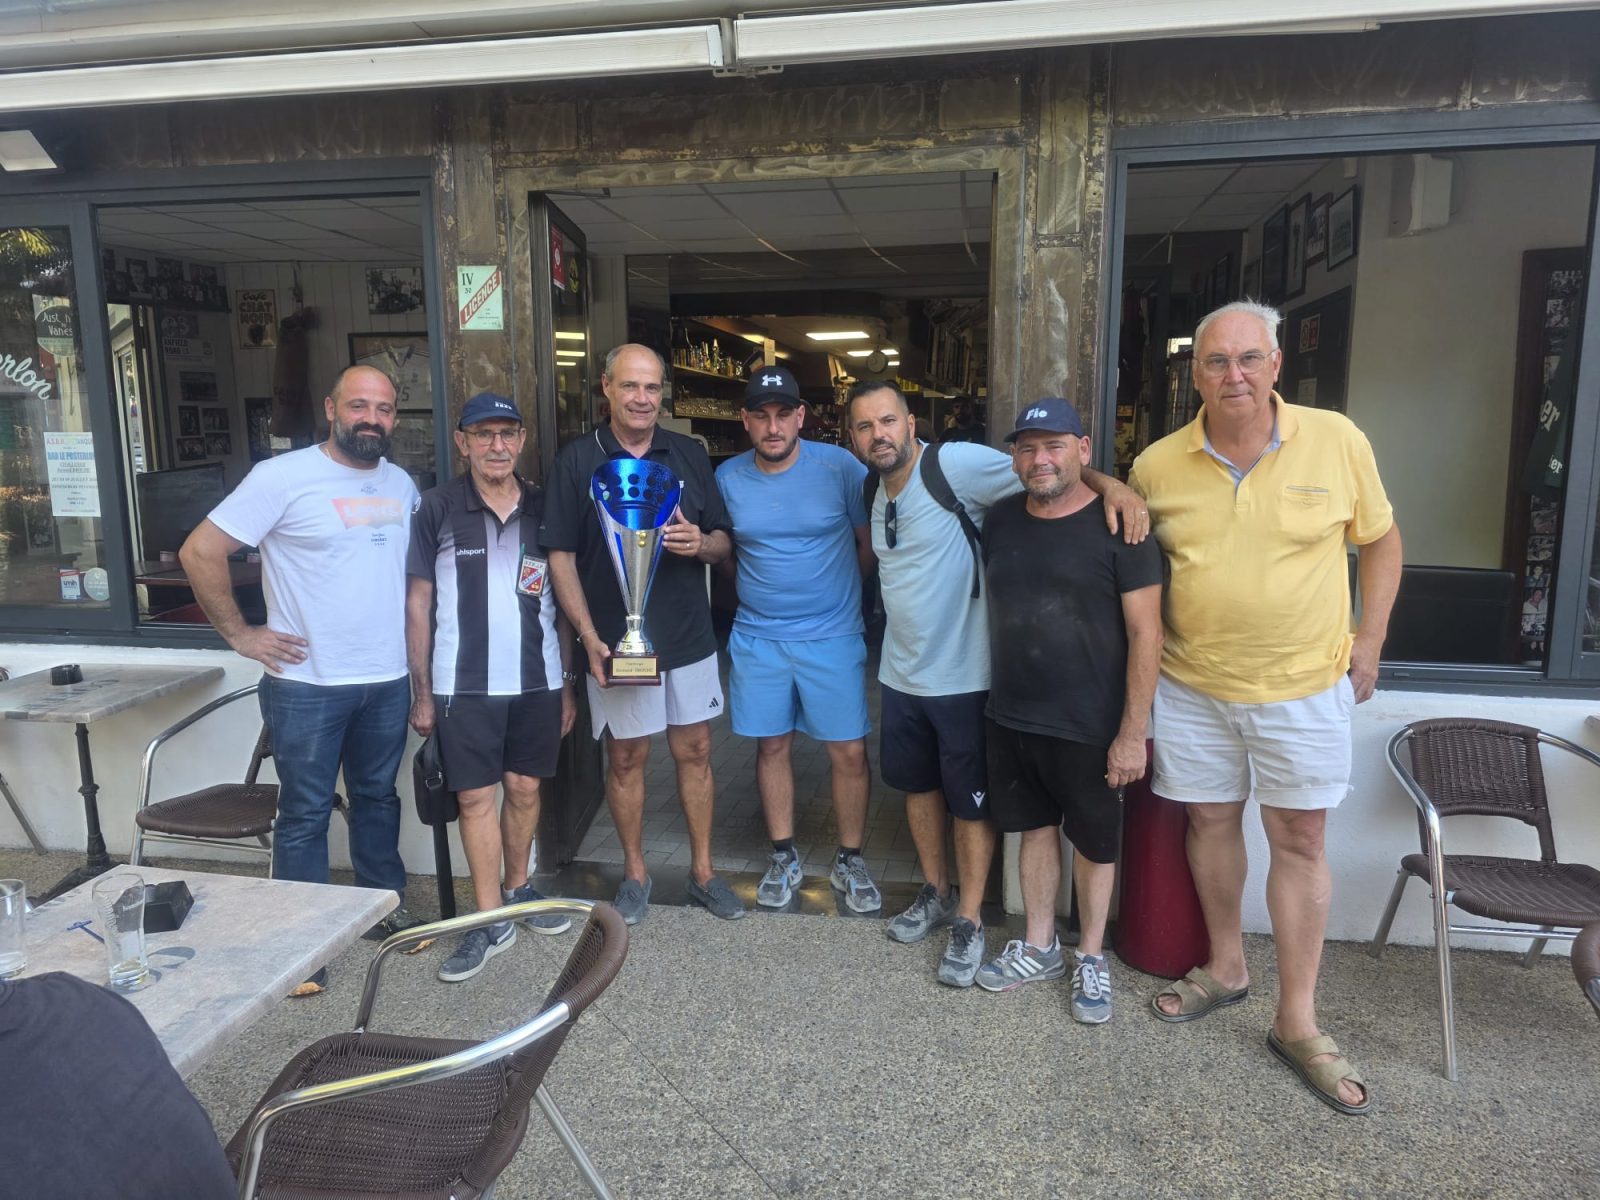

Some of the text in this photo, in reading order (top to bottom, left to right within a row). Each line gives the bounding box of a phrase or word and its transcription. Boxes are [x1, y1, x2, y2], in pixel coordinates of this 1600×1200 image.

[461, 272, 474, 286] IV
[463, 273, 498, 322] LICENCE
[456, 548, 486, 556] uhlsport
